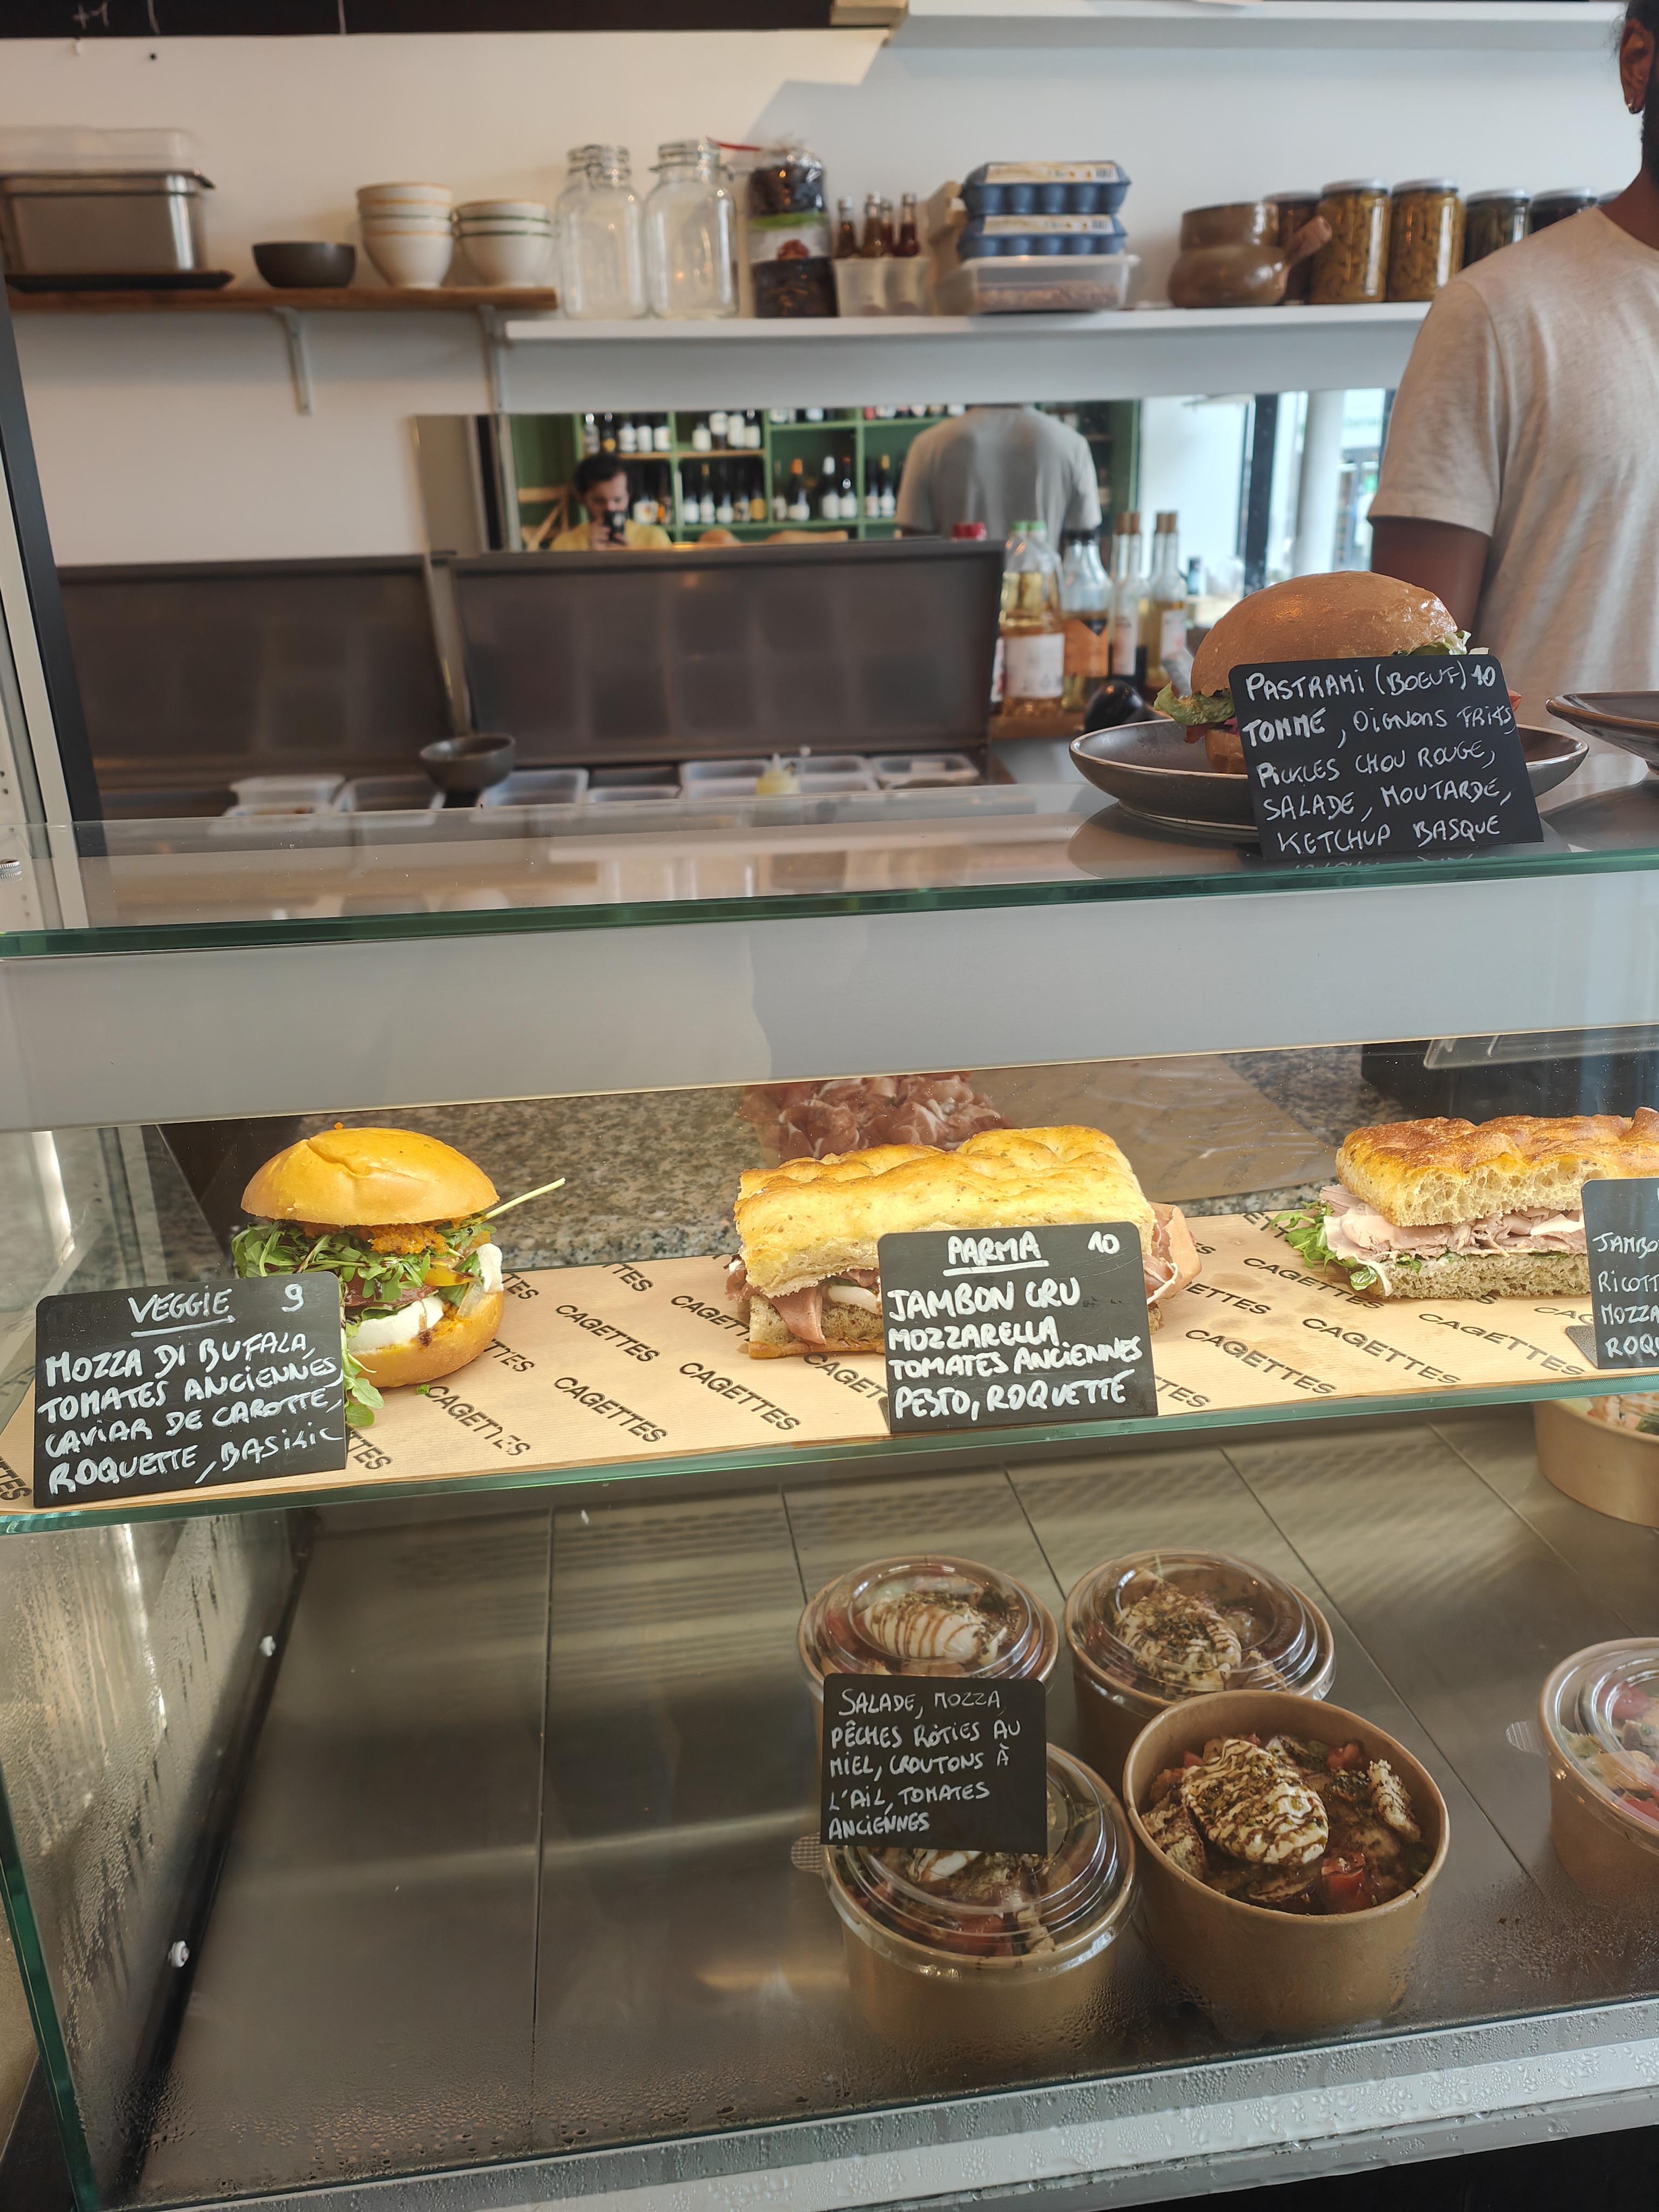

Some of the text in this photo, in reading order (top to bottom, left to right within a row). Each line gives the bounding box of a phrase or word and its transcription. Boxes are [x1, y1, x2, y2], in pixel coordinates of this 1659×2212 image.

[1471, 664, 1496, 687] 10
[1355, 750, 1405, 774] CHOU
[1418, 739, 1495, 770] ROUGE,
[1277, 815, 1501, 854] KETCHUP BASQUE
[948, 1231, 1120, 1266] PARMA 10
[1593, 1232, 1659, 1259] JAMBO
[281, 1283, 304, 1312] 9
[887, 1277, 1081, 1321] JAMBON CRU
[1182, 1282, 1272, 1314] ETTES
[1243, 1258, 1384, 1309] CAGETTES
[555, 1305, 660, 1362] CAGETTES
[888, 1315, 1060, 1351] MOZZARELLA
[1302, 1318, 1461, 1384] CAGETTES
[1419, 1313, 1586, 1375] CAGETTES
[45, 1332, 315, 1387] MOZZA DI BUFALA,
[804, 1353, 888, 1399] CAGET
[888, 1351, 1009, 1380] TOMATES
[1185, 1329, 1337, 1394] CAGETTES
[37, 1380, 170, 1424] TOMATES
[165, 1410, 203, 1437] DE
[212, 1389, 342, 1427] CAROTTE,
[554, 1377, 668, 1442] CAGETTES
[679, 1363, 801, 1431] CAGETTES
[895, 1386, 979, 1421] PESTO,
[987, 1368, 1135, 1412] ROQUETTE
[838, 1688, 923, 1719] SALADE,
[831, 1719, 902, 1749] PÊCHES
[994, 1719, 1021, 1739] AU
[889, 1752, 984, 1775] CROUTONS
[898, 1782, 990, 1805] TOMATES
